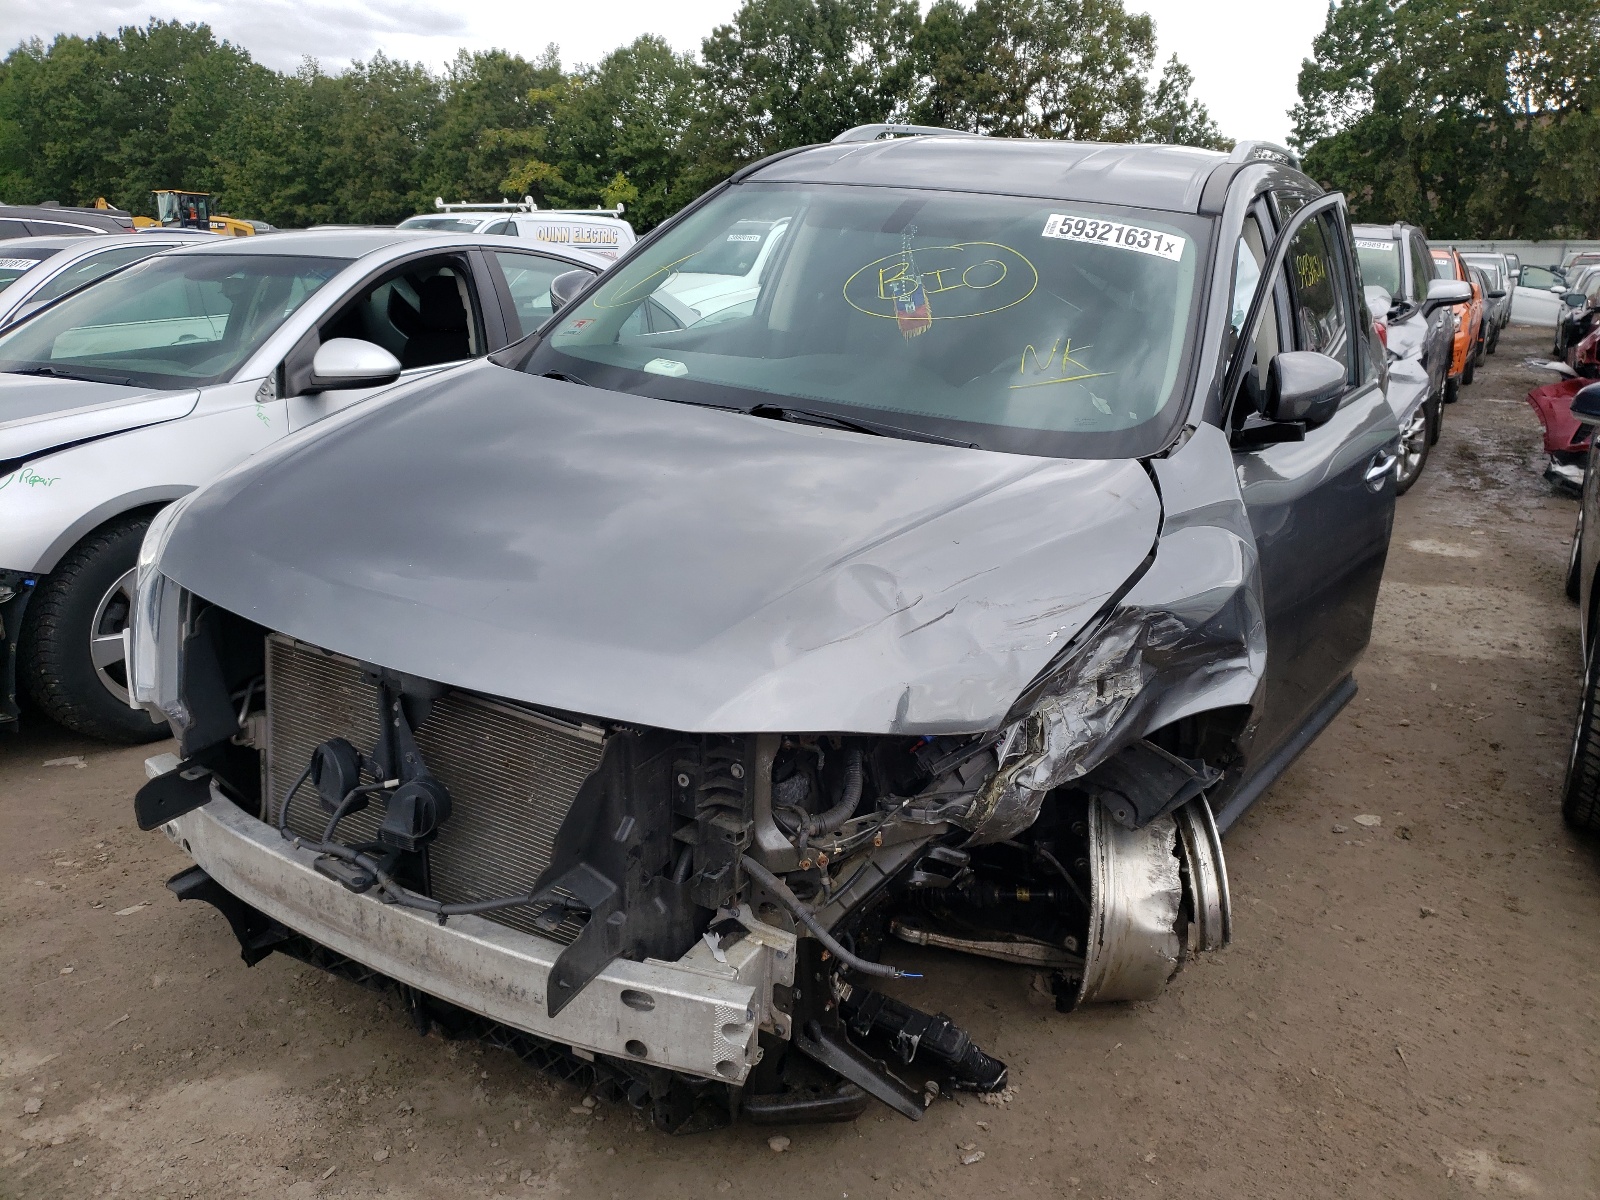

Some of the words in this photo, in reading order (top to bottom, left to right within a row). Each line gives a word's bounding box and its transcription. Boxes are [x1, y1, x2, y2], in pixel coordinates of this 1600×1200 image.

[536, 225, 570, 244] QUINN
[572, 226, 618, 245] ELECTRIC
[876, 259, 1008, 300] BIO
[1020, 338, 1094, 375] NK
